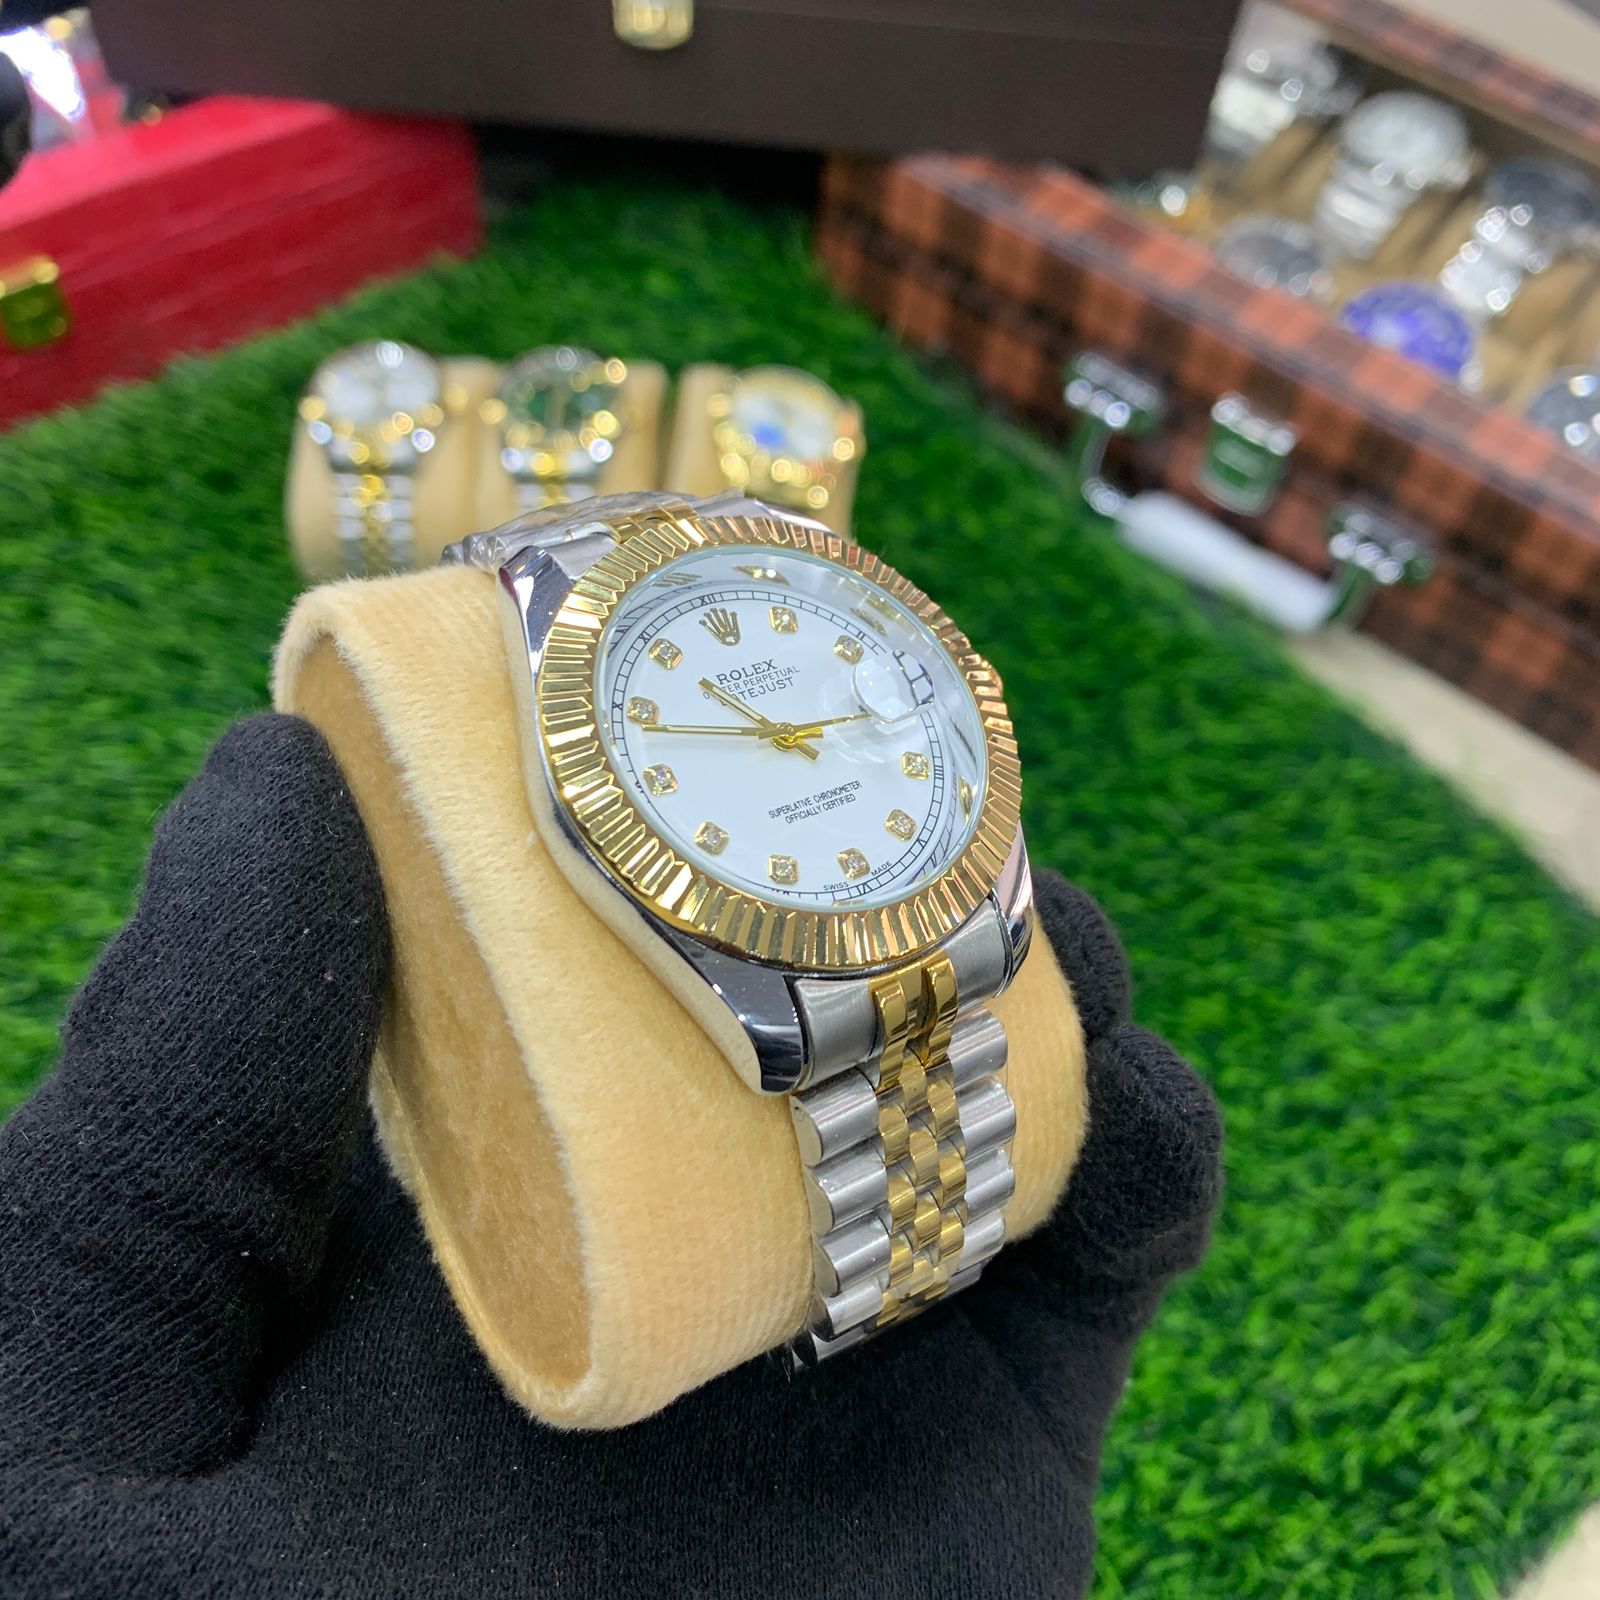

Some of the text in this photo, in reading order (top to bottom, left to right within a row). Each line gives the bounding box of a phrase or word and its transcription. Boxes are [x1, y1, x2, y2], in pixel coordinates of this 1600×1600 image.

[716, 659, 778, 686] ROLEX
[743, 665, 800, 688] PERPETUAL
[768, 780, 862, 819] SUPERLATIVE CHRONOMETER
[785, 793, 856, 824] OFFICIALLY CERTIFIED
[823, 861, 893, 891] SWISS MADE
